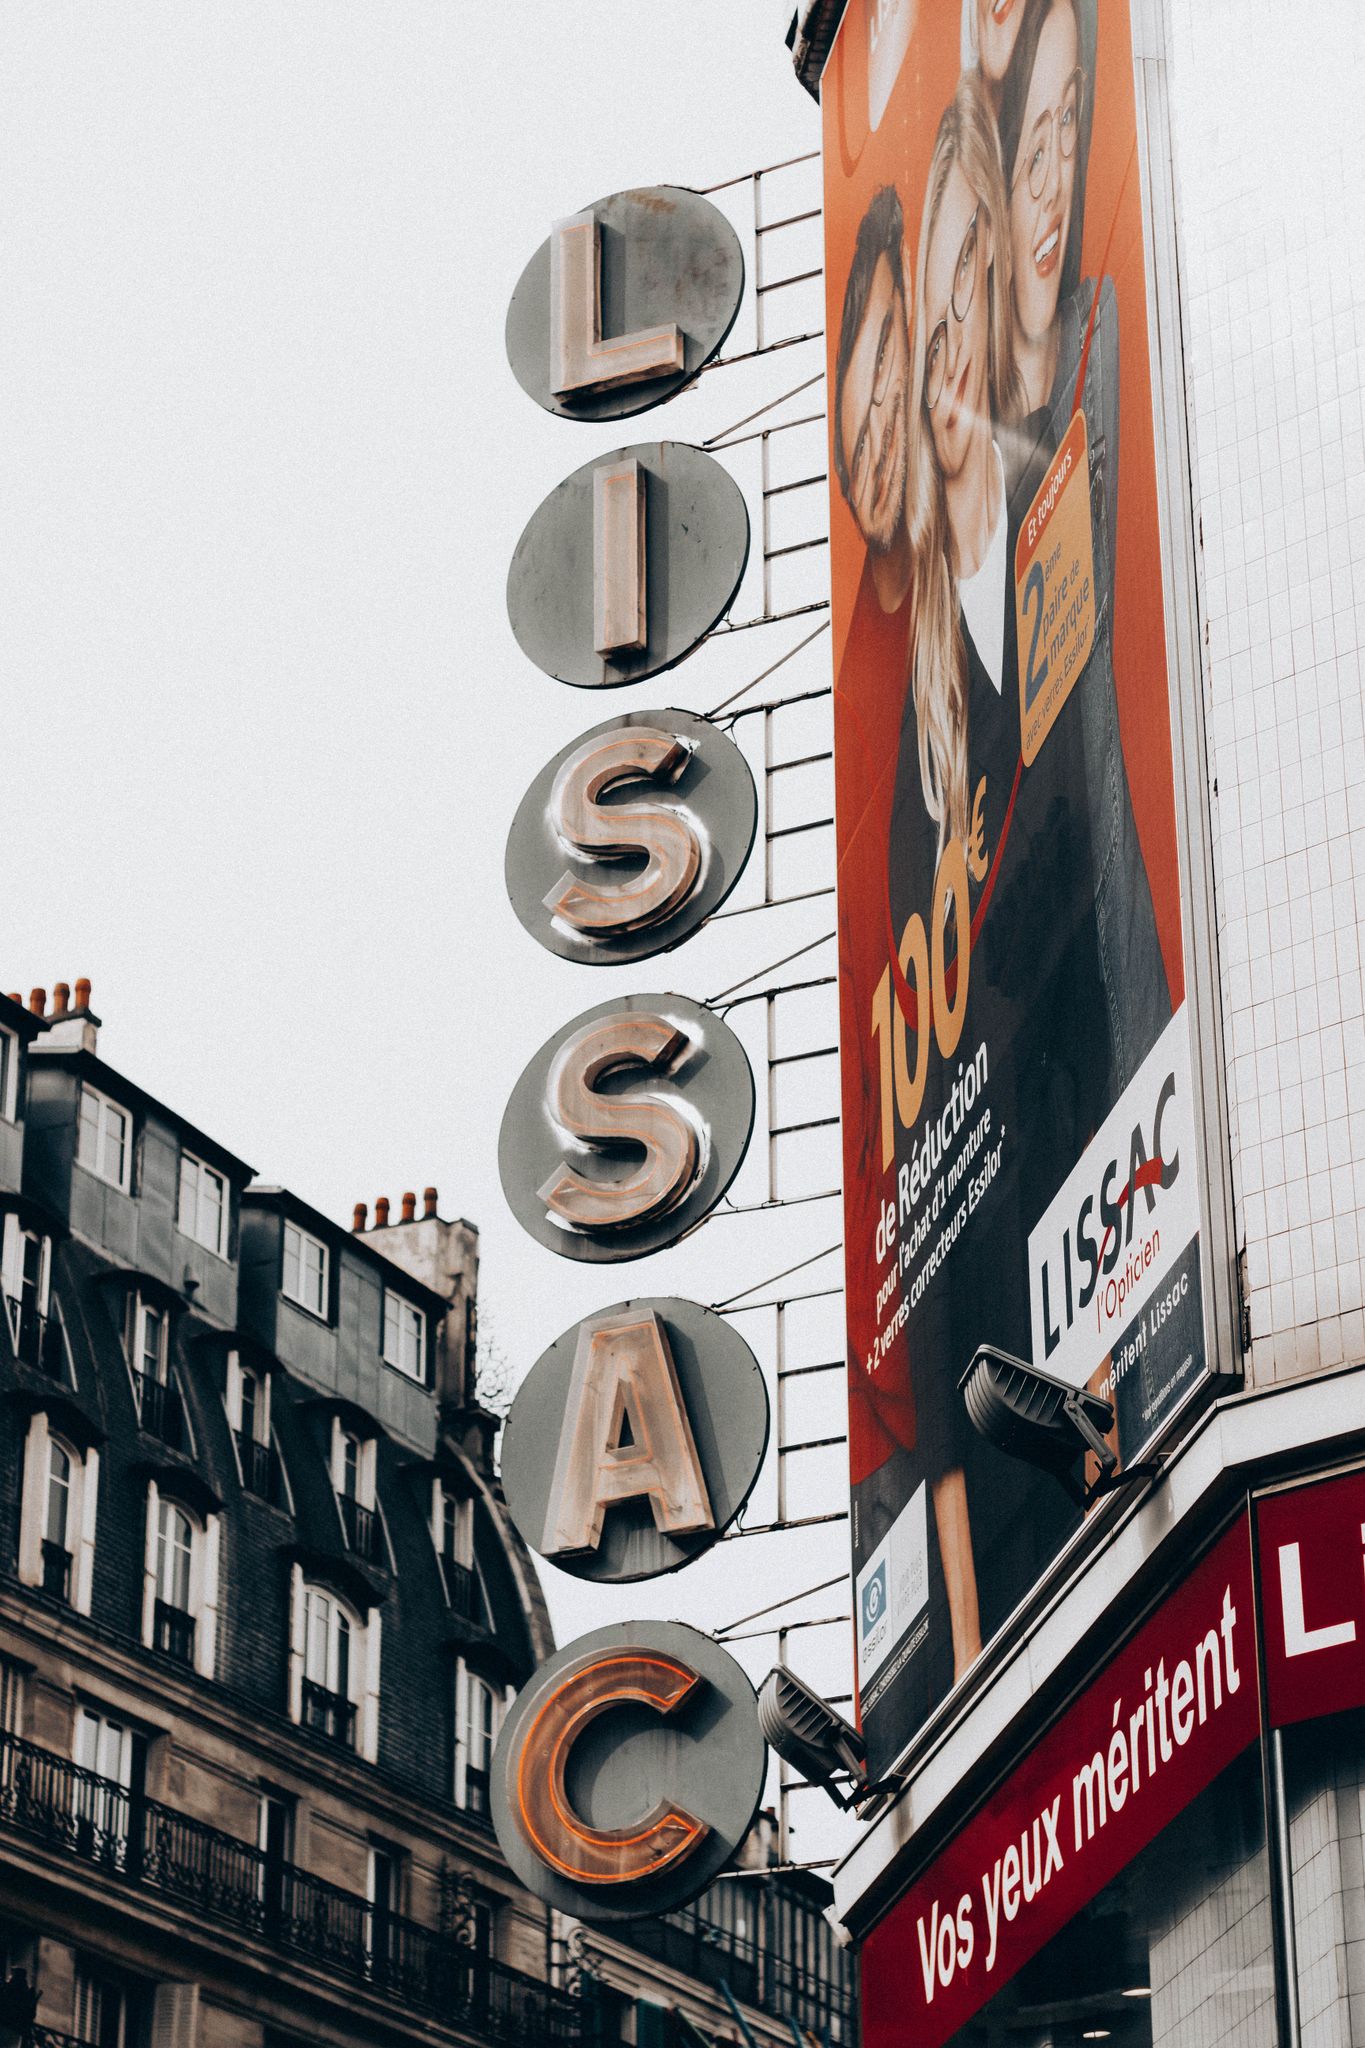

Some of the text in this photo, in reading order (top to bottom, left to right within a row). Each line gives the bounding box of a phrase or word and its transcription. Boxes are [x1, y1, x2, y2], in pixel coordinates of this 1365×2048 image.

[1027, 448, 1072, 547] Et toujours
[1042, 557, 1080, 641] paire de
[1050, 576, 1090, 668] marque
[1026, 717, 1041, 750] avec
[1041, 676, 1063, 725] verres
[506, 208, 715, 1888] LISSAC
[876, 1041, 988, 1265] de Réduction
[876, 1262, 898, 1325] pour
[899, 1203, 931, 1277] l'achat
[948, 1107, 991, 1198] monture
[1041, 1071, 1179, 1361] LISSAC
[873, 1337, 879, 1375] 2
[880, 1299, 910, 1357] verres
[911, 1200, 966, 1307] correcteurs
[1096, 1229, 1160, 1334] l'Opticien
[1099, 1272, 1188, 1400] méritent Lissac
[1278, 1523, 1365, 1658] L
[916, 1583, 1241, 2005] Vos yeux méritent
